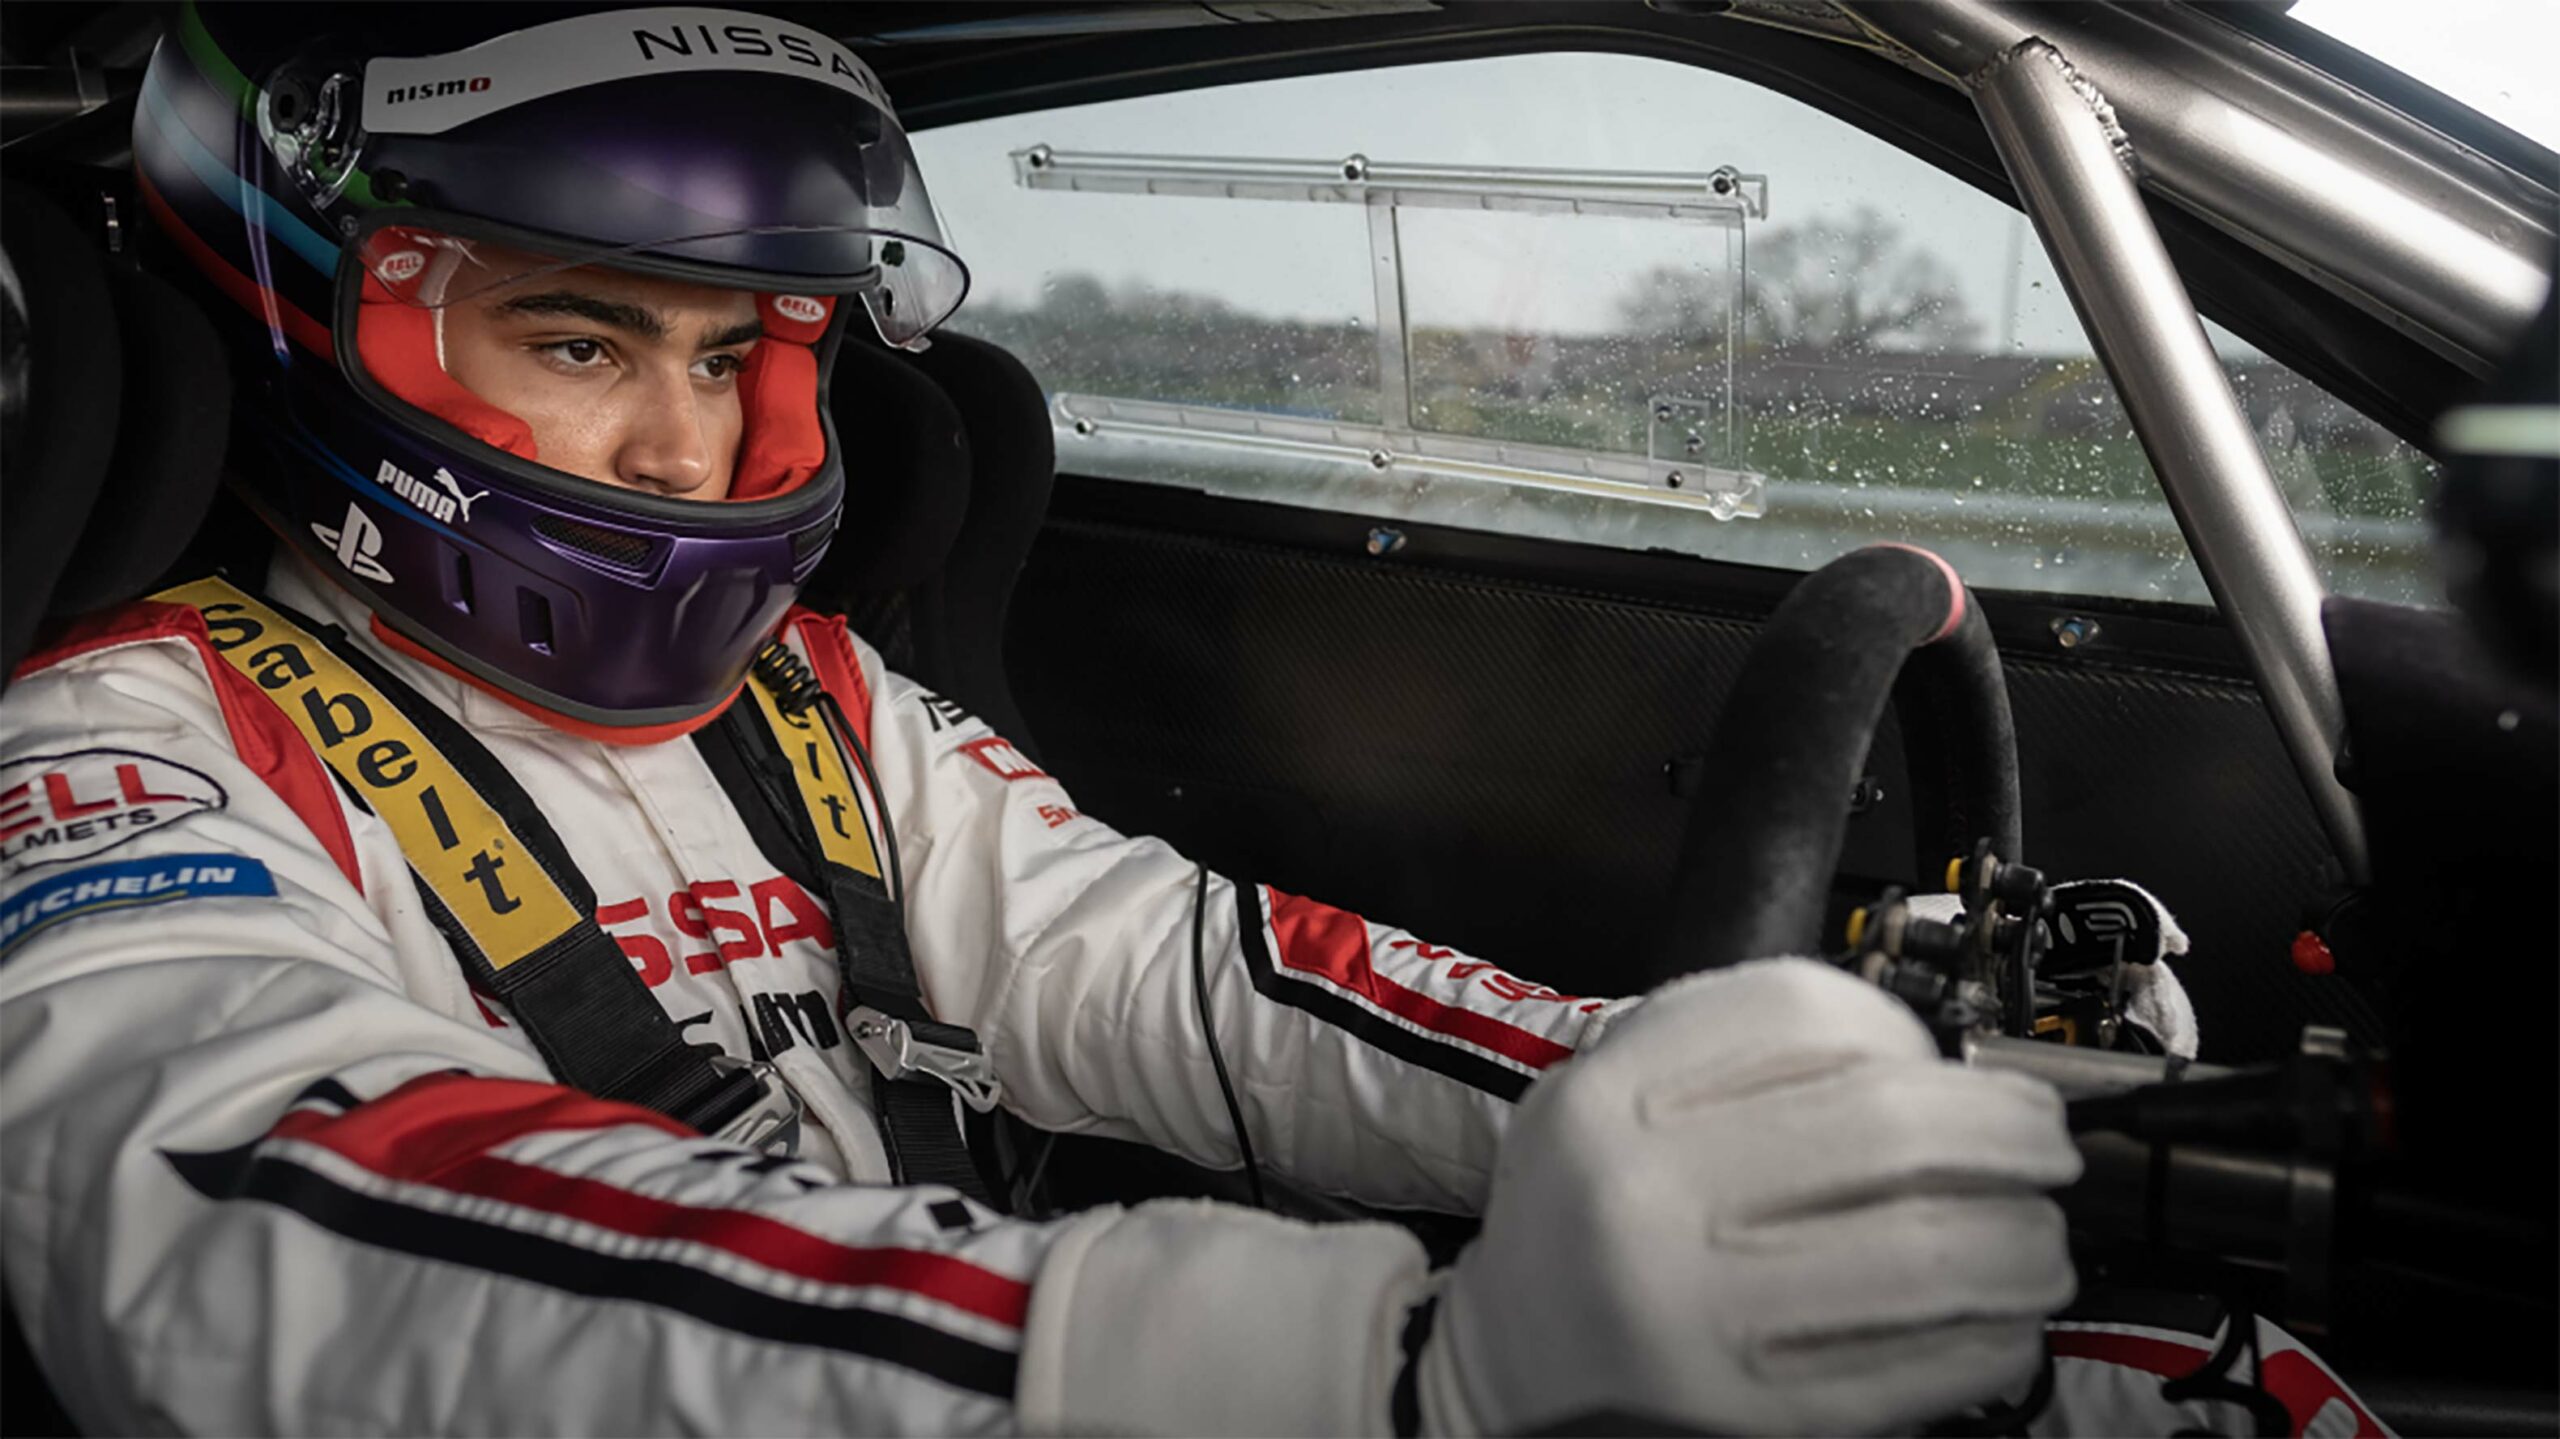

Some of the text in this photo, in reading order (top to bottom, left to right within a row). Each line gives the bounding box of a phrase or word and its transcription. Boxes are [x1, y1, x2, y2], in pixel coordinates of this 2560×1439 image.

[387, 77, 492, 105] nismo
[385, 255, 419, 274] BELL
[780, 297, 818, 316] BELL
[376, 459, 457, 524] PUMA
[200, 603, 522, 915] Sabelt
[0, 764, 188, 842] ELL
[0, 807, 157, 862] LMETS
[595, 875, 836, 988] SSA
